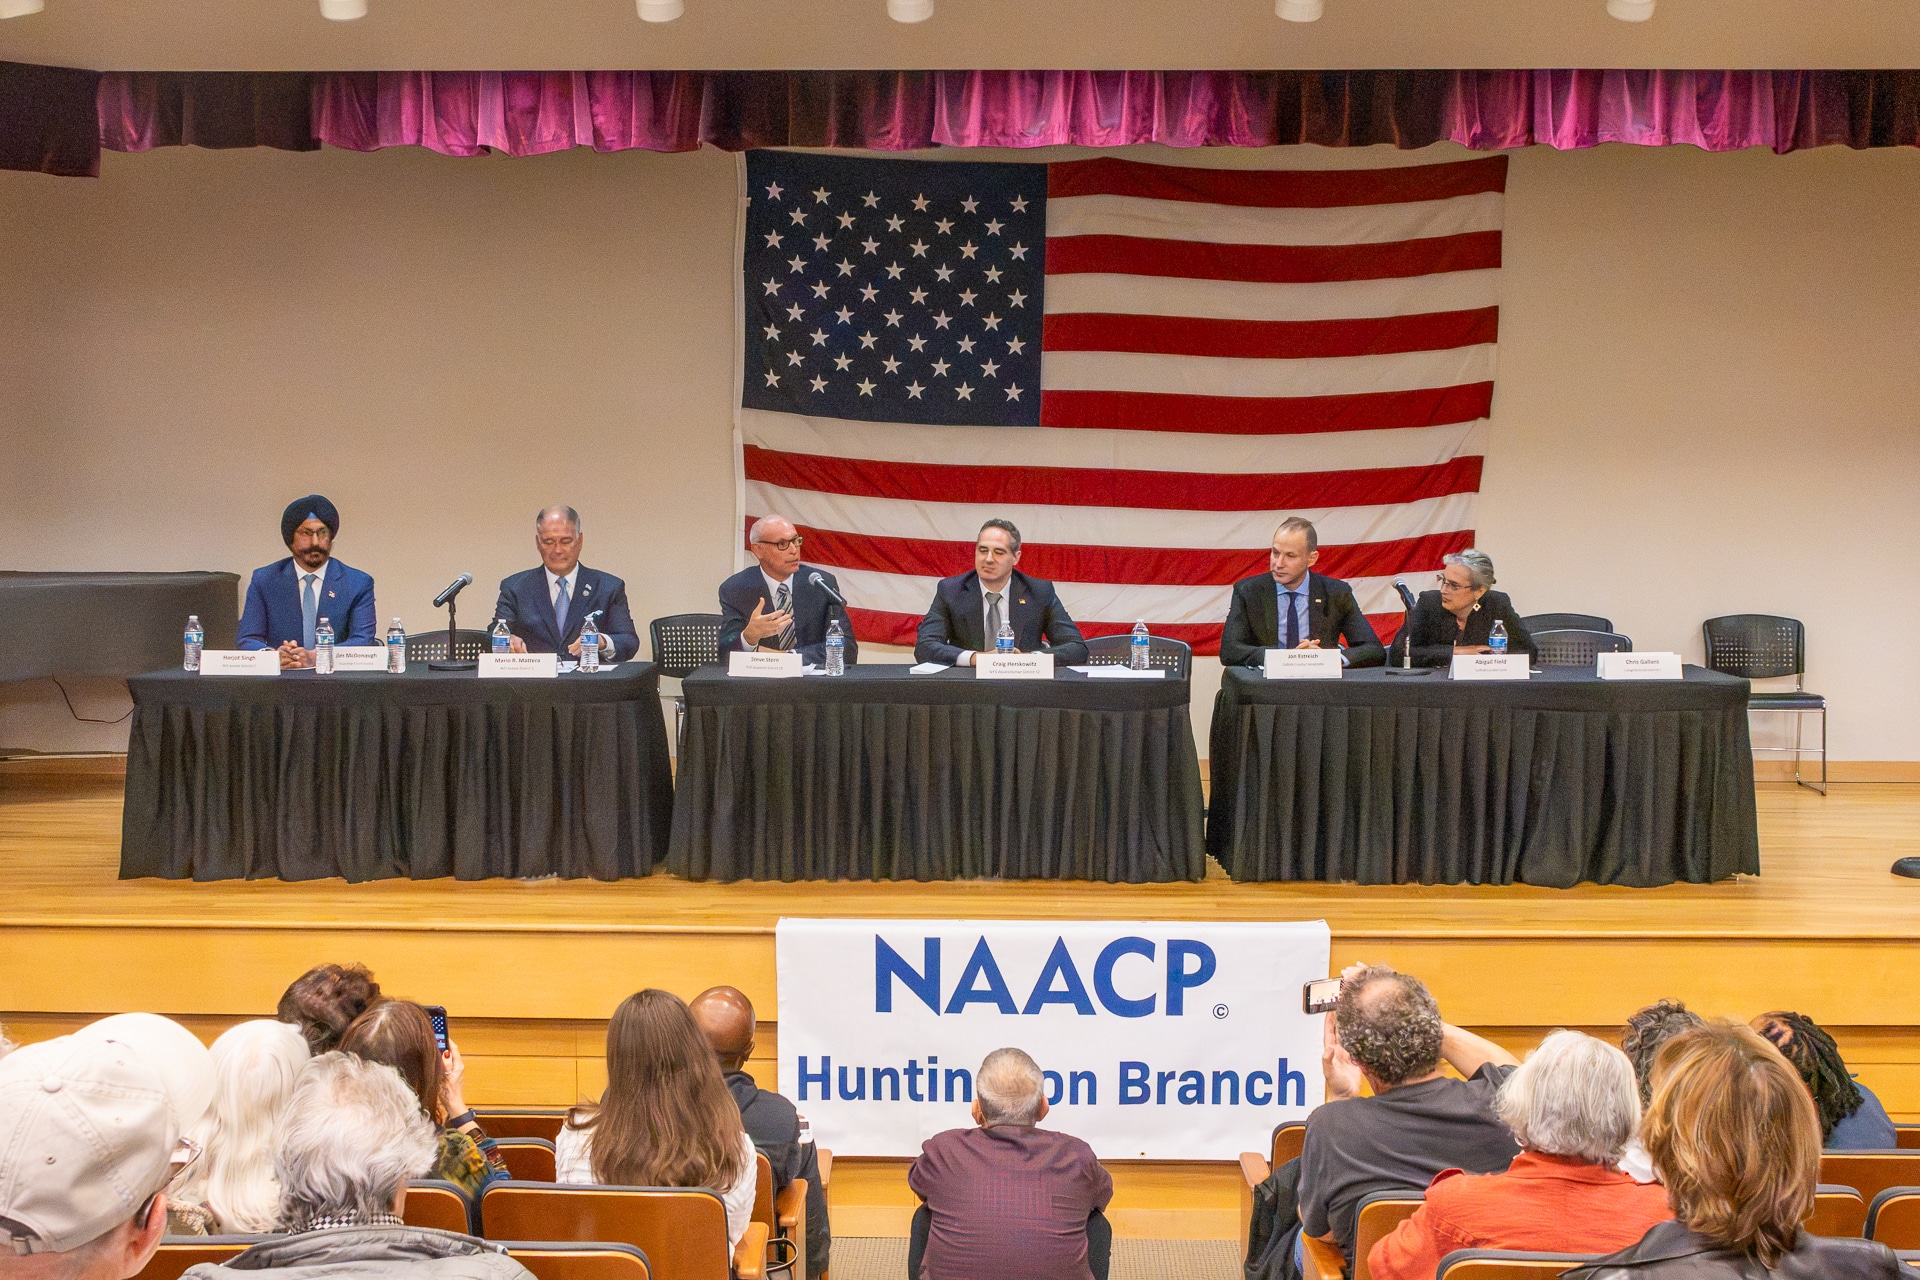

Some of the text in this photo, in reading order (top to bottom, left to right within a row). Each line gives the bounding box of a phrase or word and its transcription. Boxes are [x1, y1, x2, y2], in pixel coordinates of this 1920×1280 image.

[875, 935, 1217, 1018] NAACP
[797, 1055, 1306, 1107] Huntinon Branch
